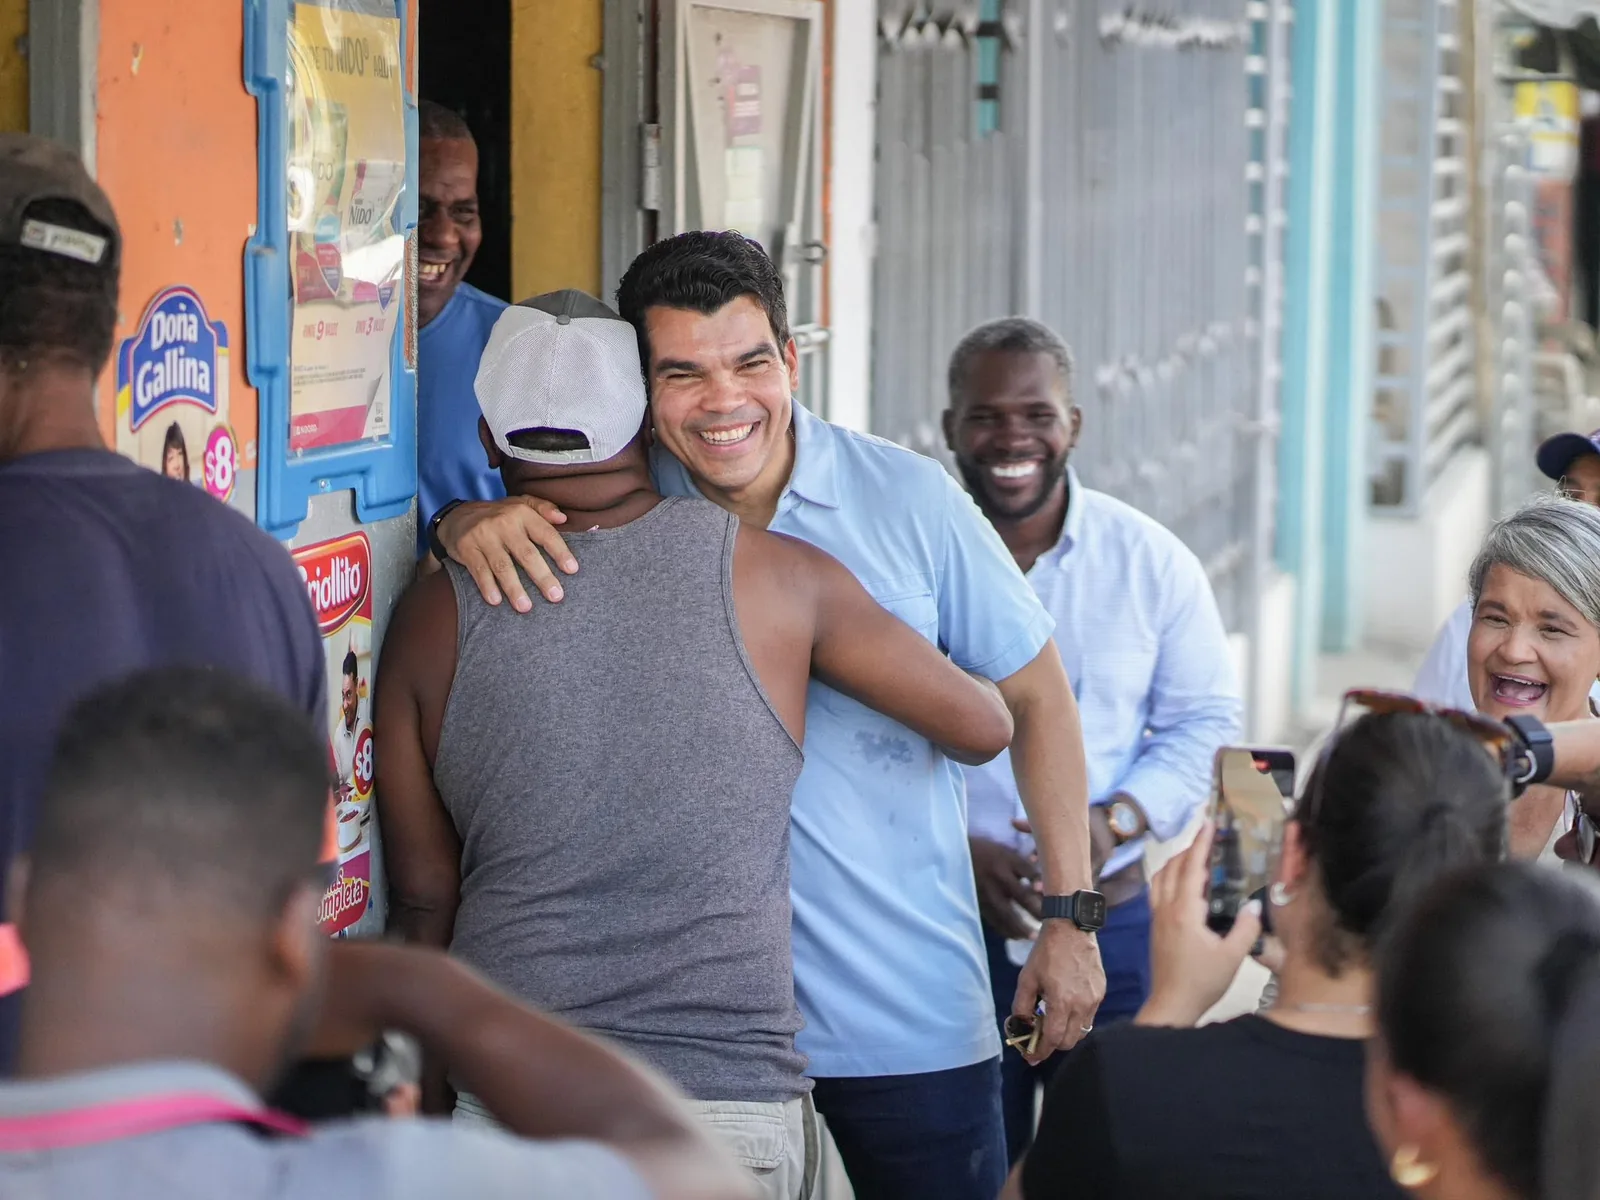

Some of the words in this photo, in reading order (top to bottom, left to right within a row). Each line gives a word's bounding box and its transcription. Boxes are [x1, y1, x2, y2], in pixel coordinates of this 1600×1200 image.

[151, 303, 198, 350] Doña
[316, 320, 325, 340] 9
[366, 317, 374, 336] 3
[136, 346, 210, 408] Gallina
[206, 436, 233, 490] $8
[356, 738, 373, 781] $8
[315, 877, 363, 924] ompleta
